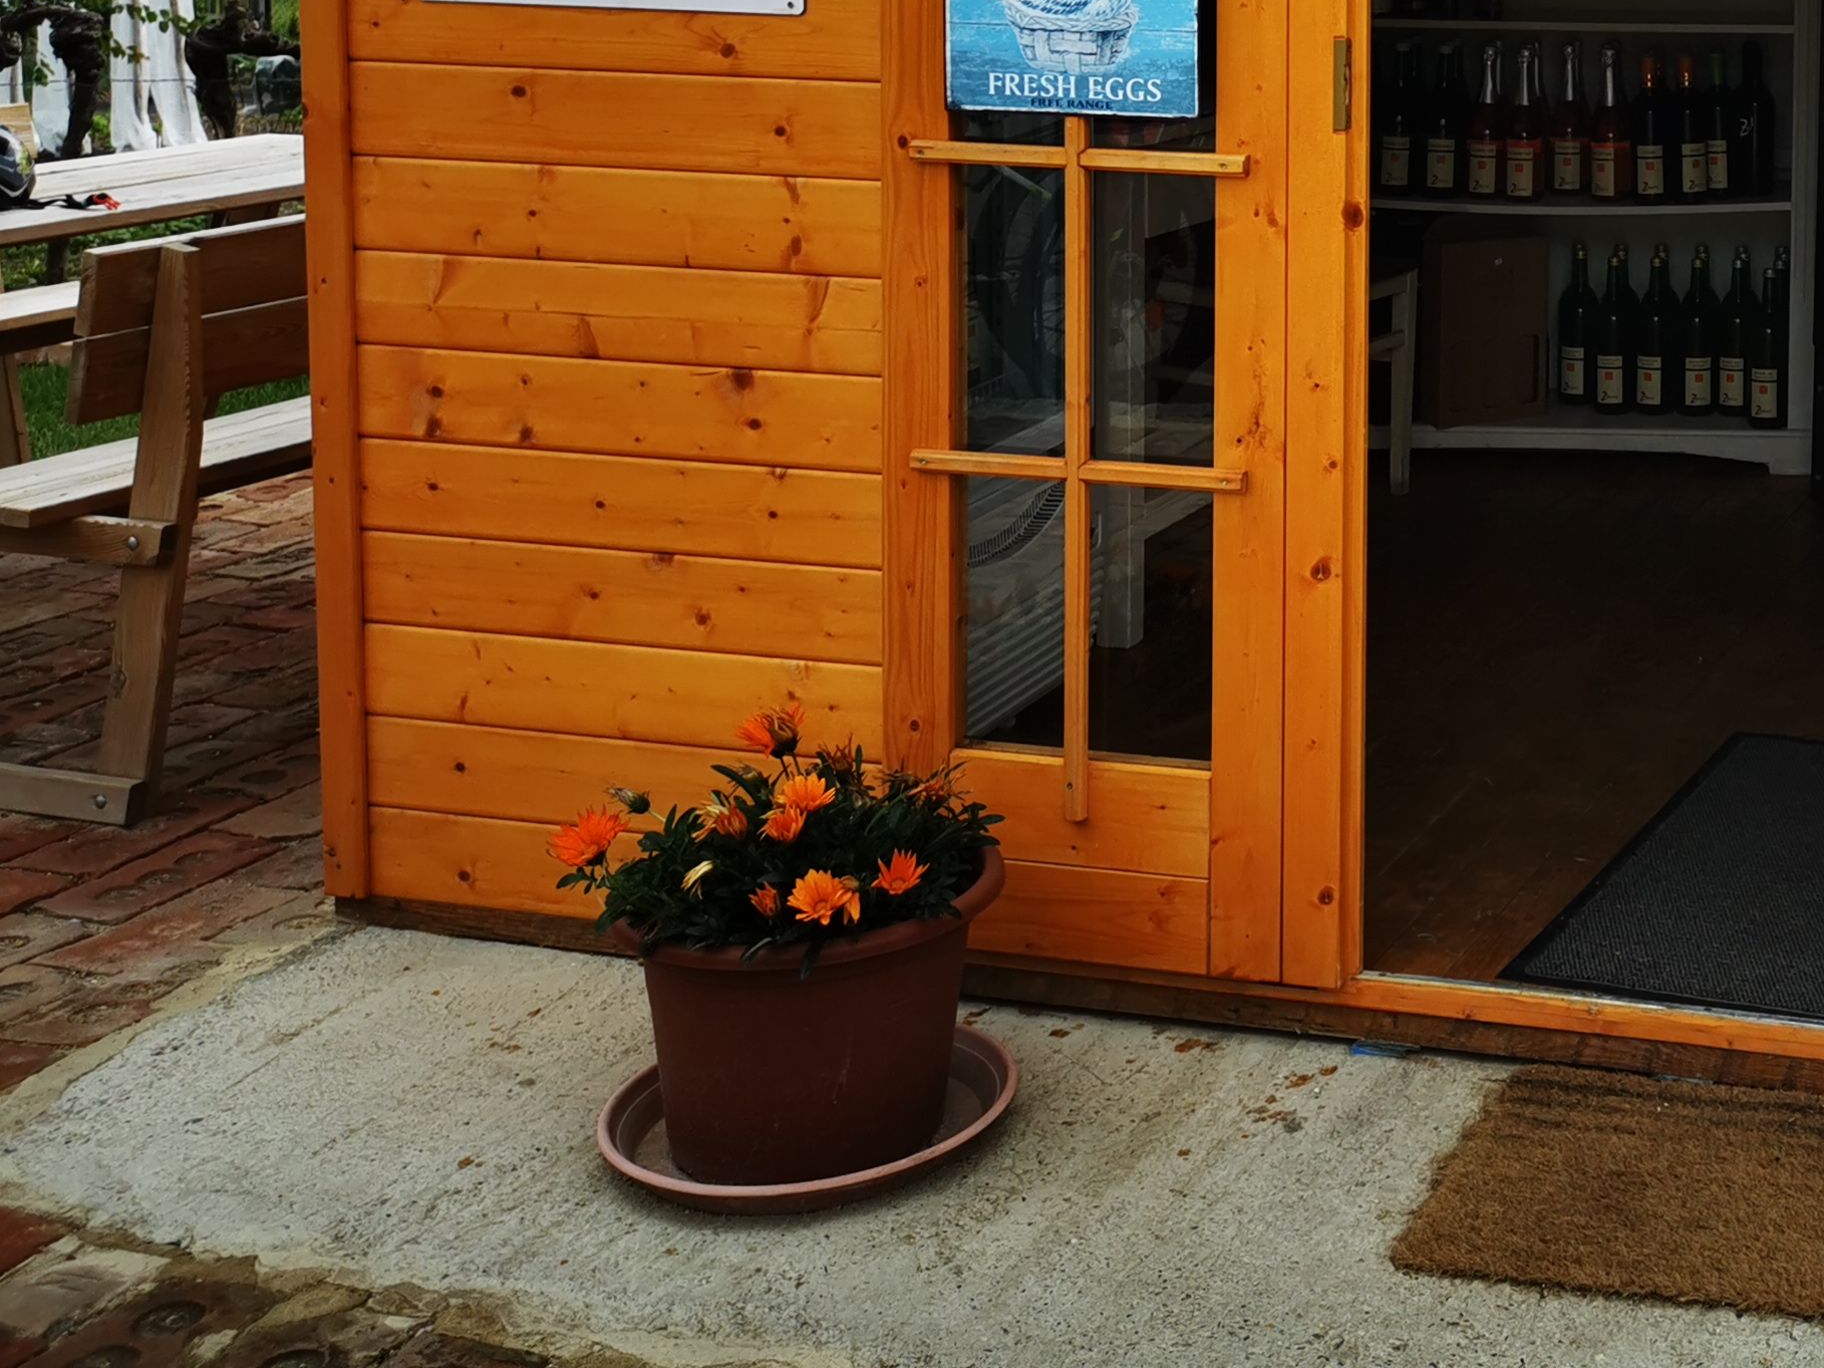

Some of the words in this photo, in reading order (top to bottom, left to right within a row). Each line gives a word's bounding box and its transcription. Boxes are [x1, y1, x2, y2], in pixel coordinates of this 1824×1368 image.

[988, 72, 1076, 99] FRESH
[1088, 77, 1162, 102] EGGS
[1030, 98, 1062, 109] FREE
[1067, 99, 1114, 110] RANGE
